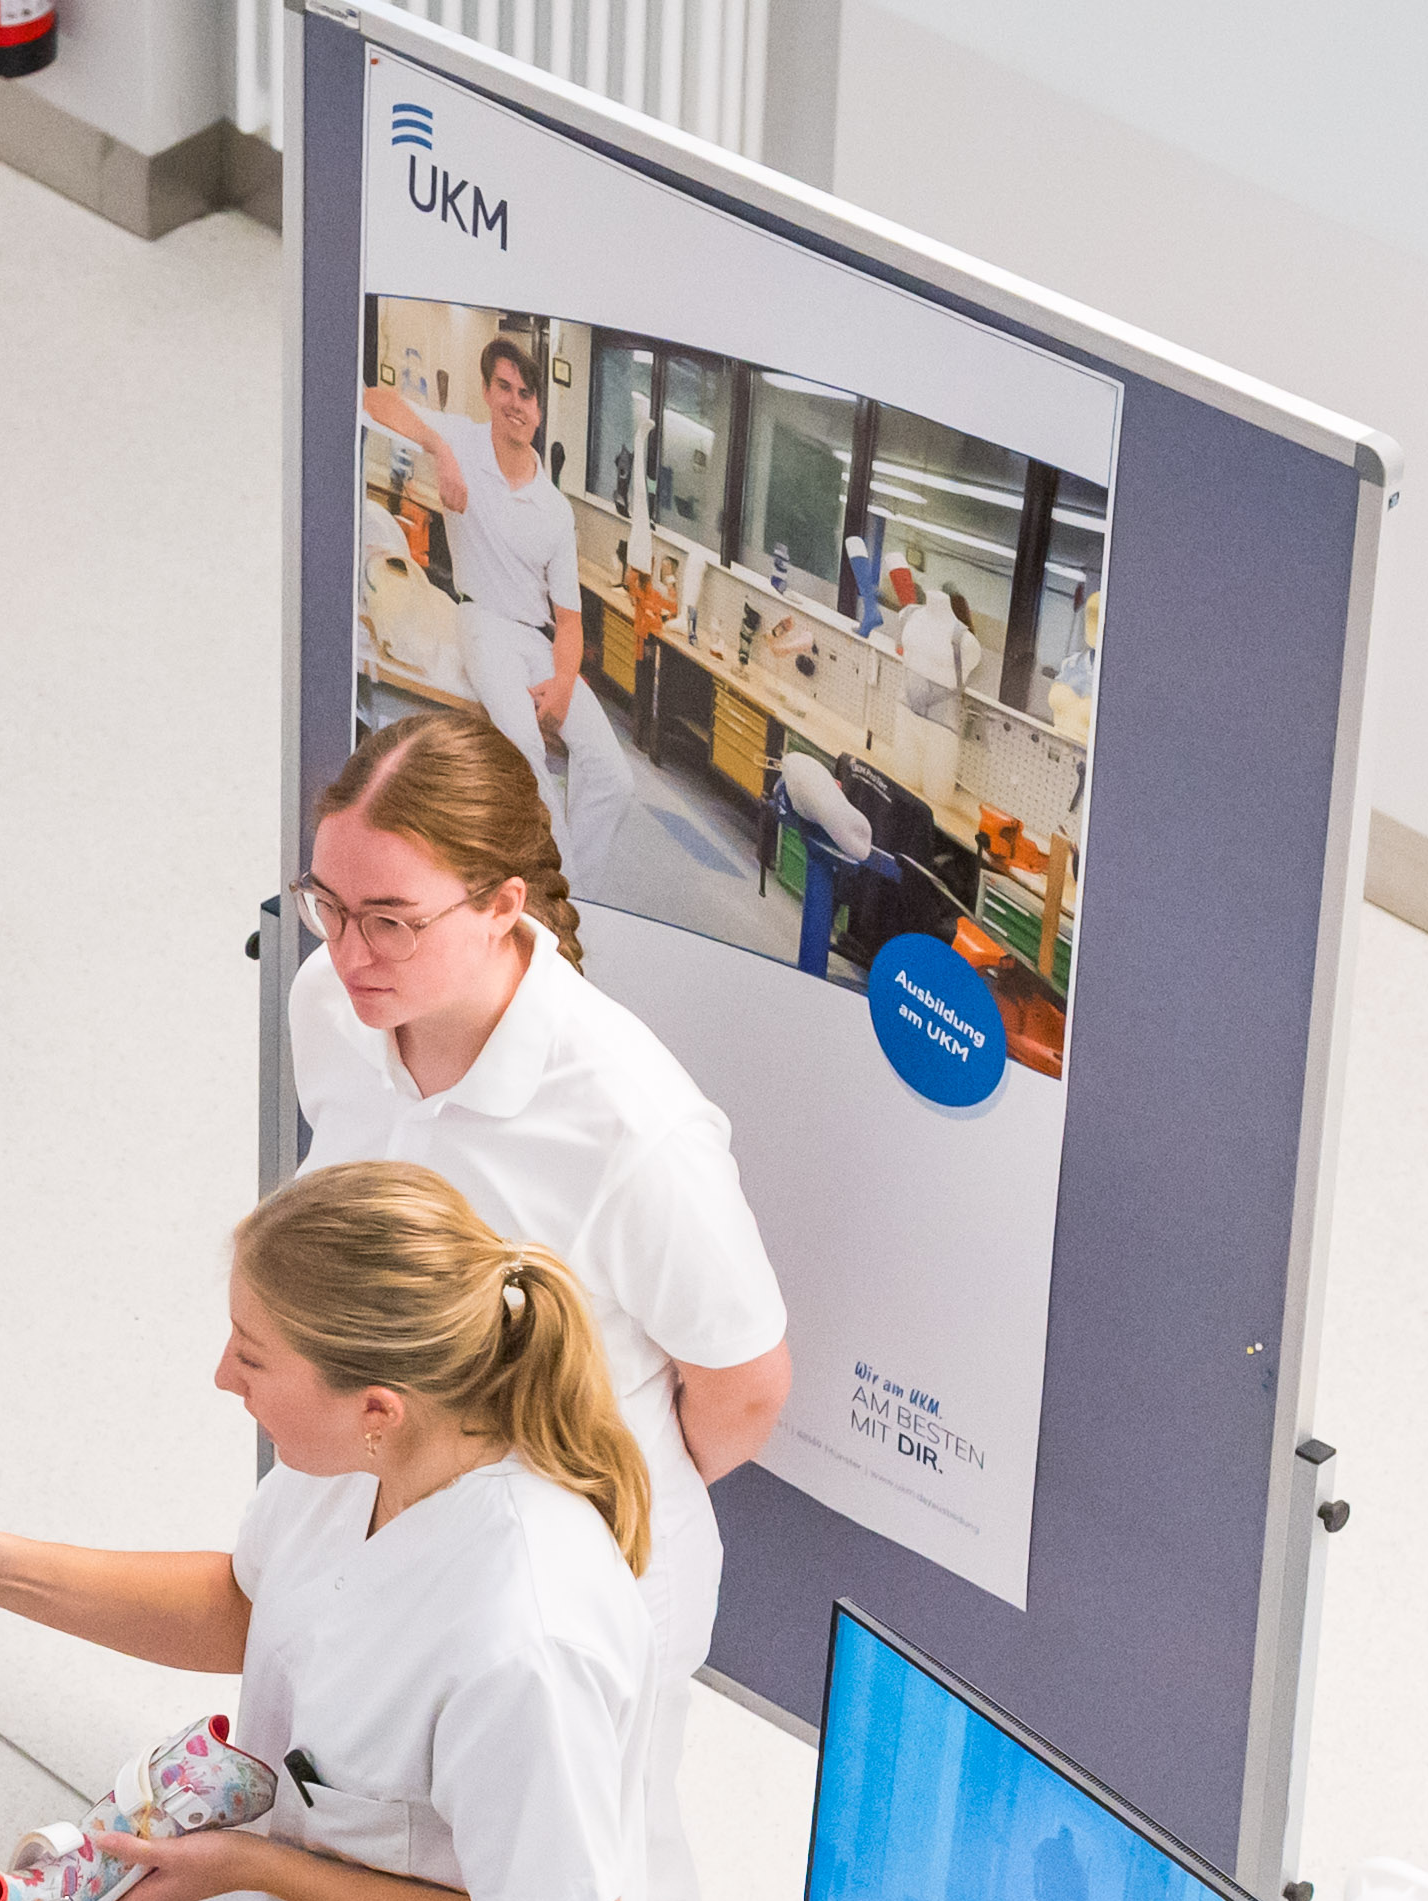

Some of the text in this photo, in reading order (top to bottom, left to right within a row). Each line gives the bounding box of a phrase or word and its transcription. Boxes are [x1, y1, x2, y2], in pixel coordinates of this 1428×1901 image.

[408, 153, 509, 251] UKM
[894, 969, 986, 1049] Ausbildung
[898, 1003, 970, 1062] am UKM
[854, 1360, 879, 1386] Wir
[882, 1378, 904, 1399] am
[850, 1408, 943, 1475] MIT DIR.
[851, 1385, 986, 1471] AM BESTEN
